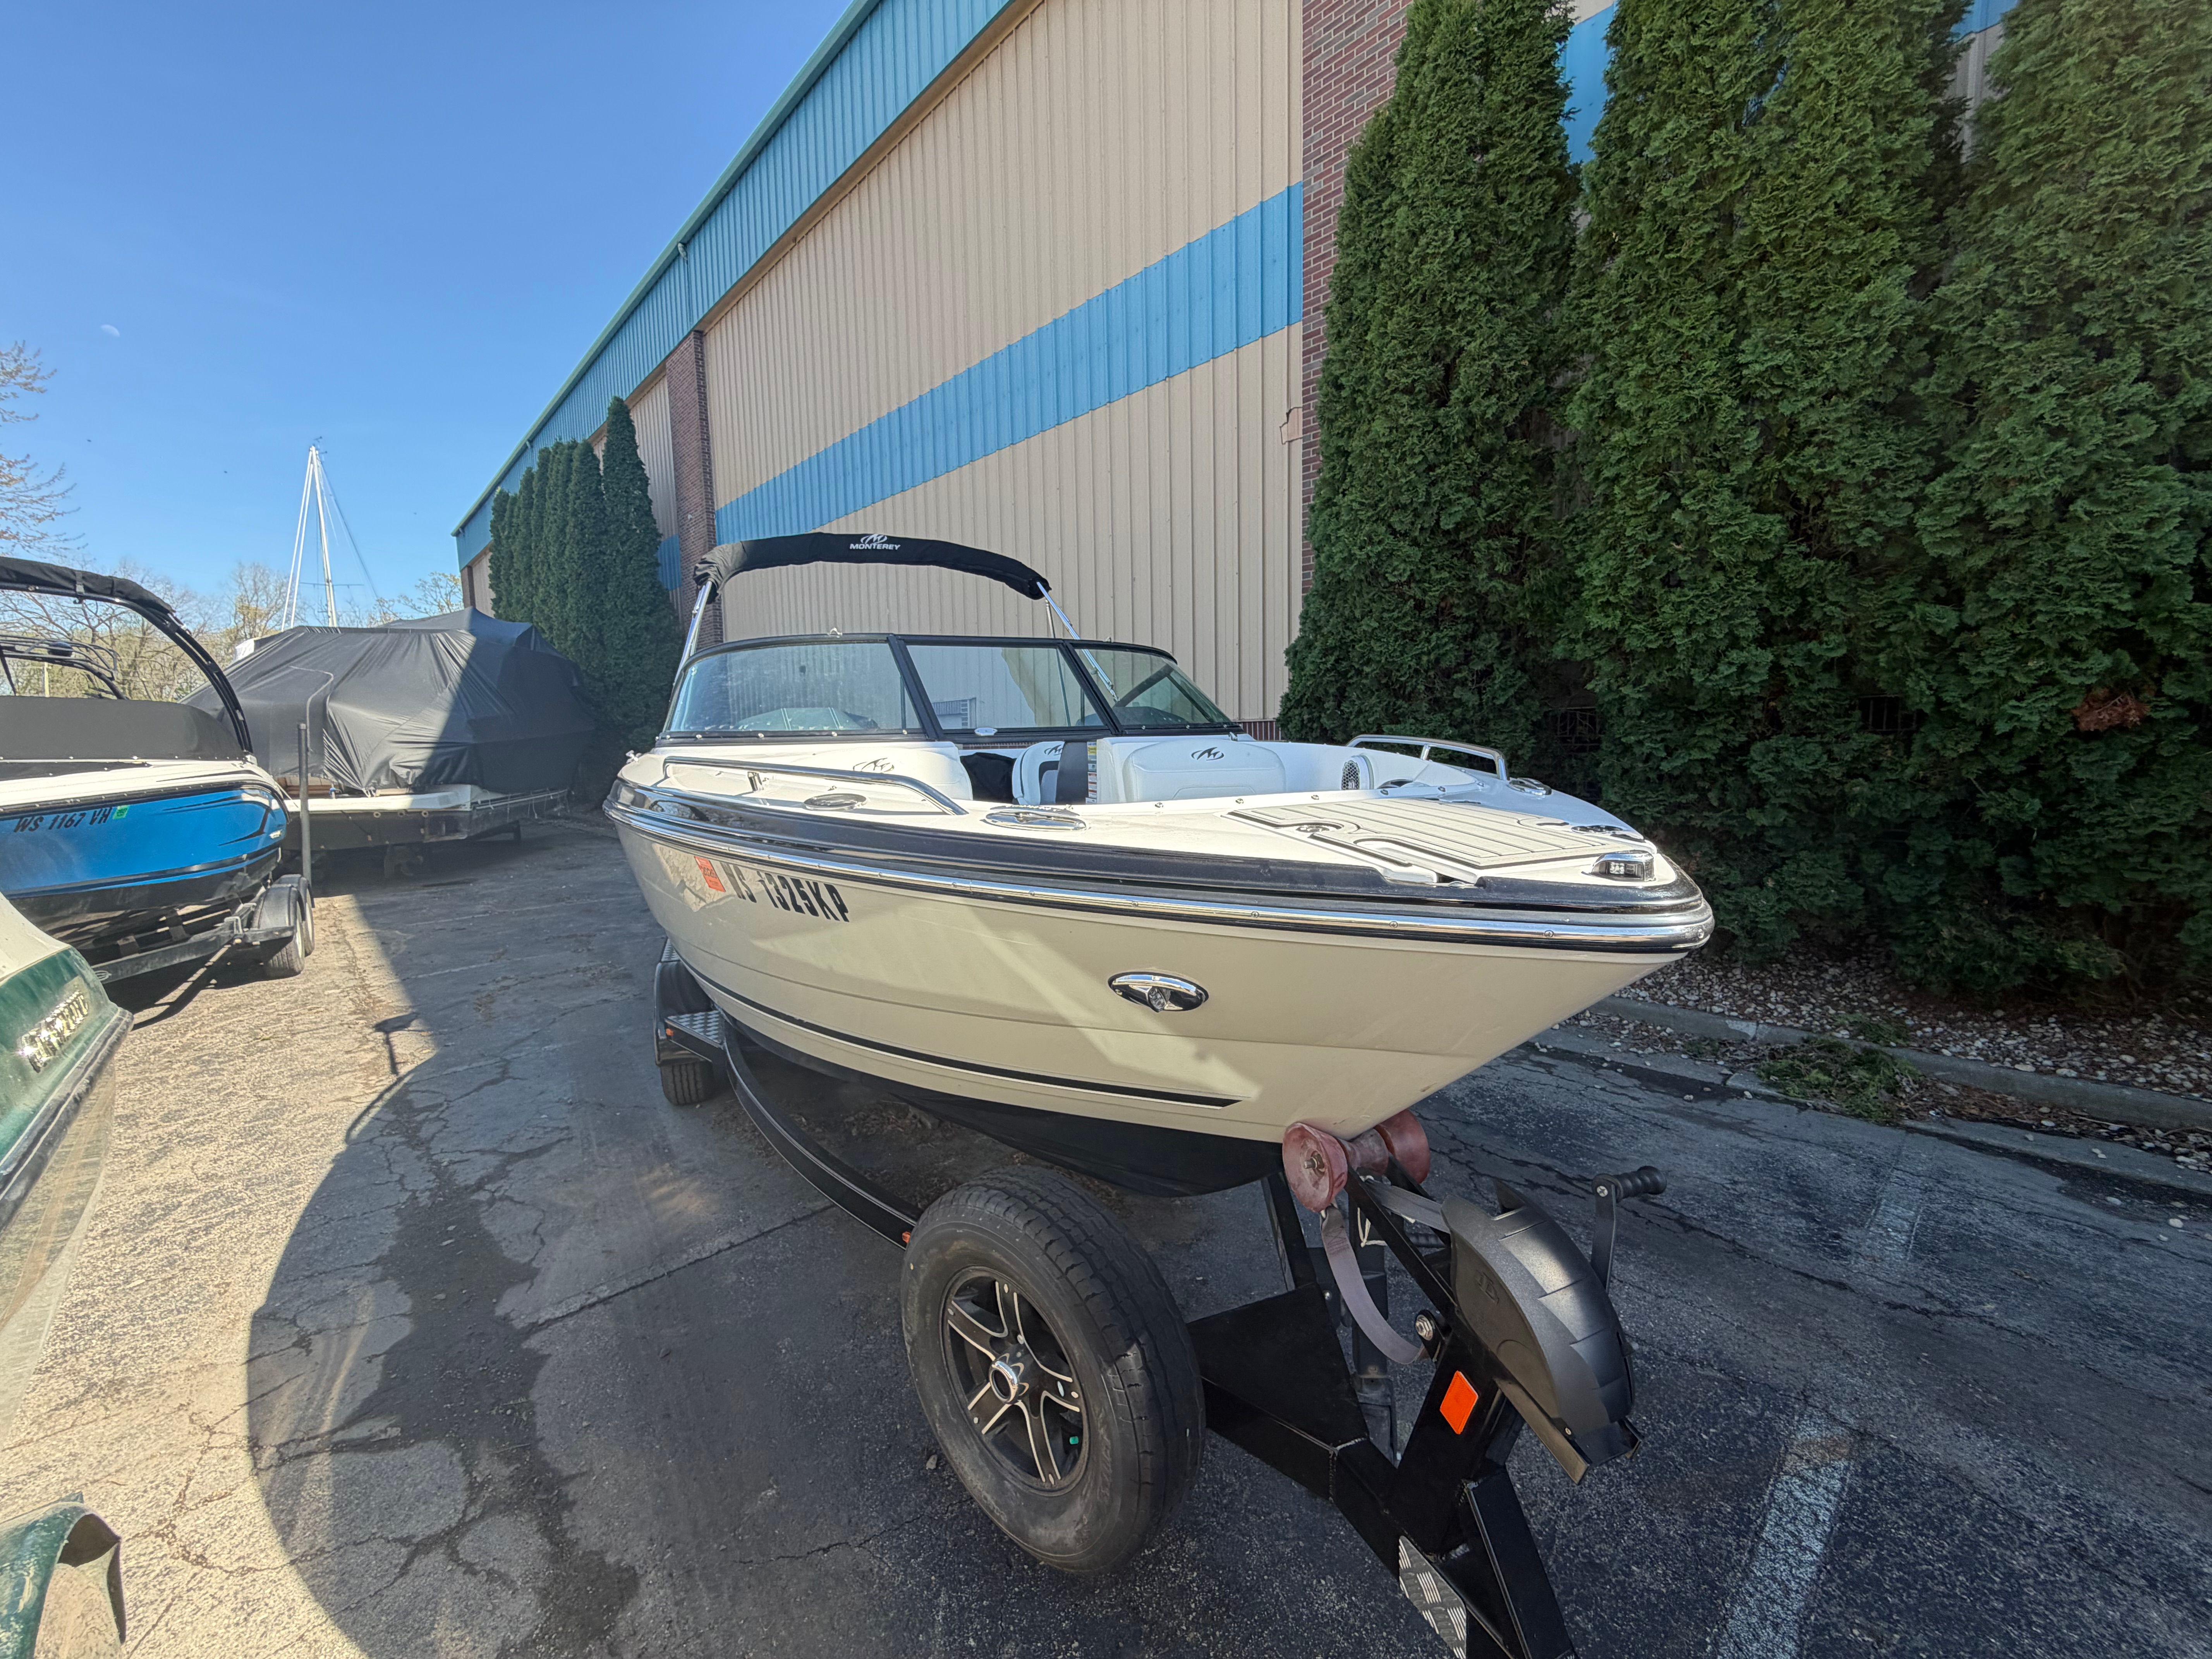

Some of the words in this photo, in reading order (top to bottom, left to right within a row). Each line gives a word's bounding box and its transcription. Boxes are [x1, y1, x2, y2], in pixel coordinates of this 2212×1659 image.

[14, 815, 44, 832] WS
[48, 812, 86, 830] 1167
[89, 807, 112, 825] VH
